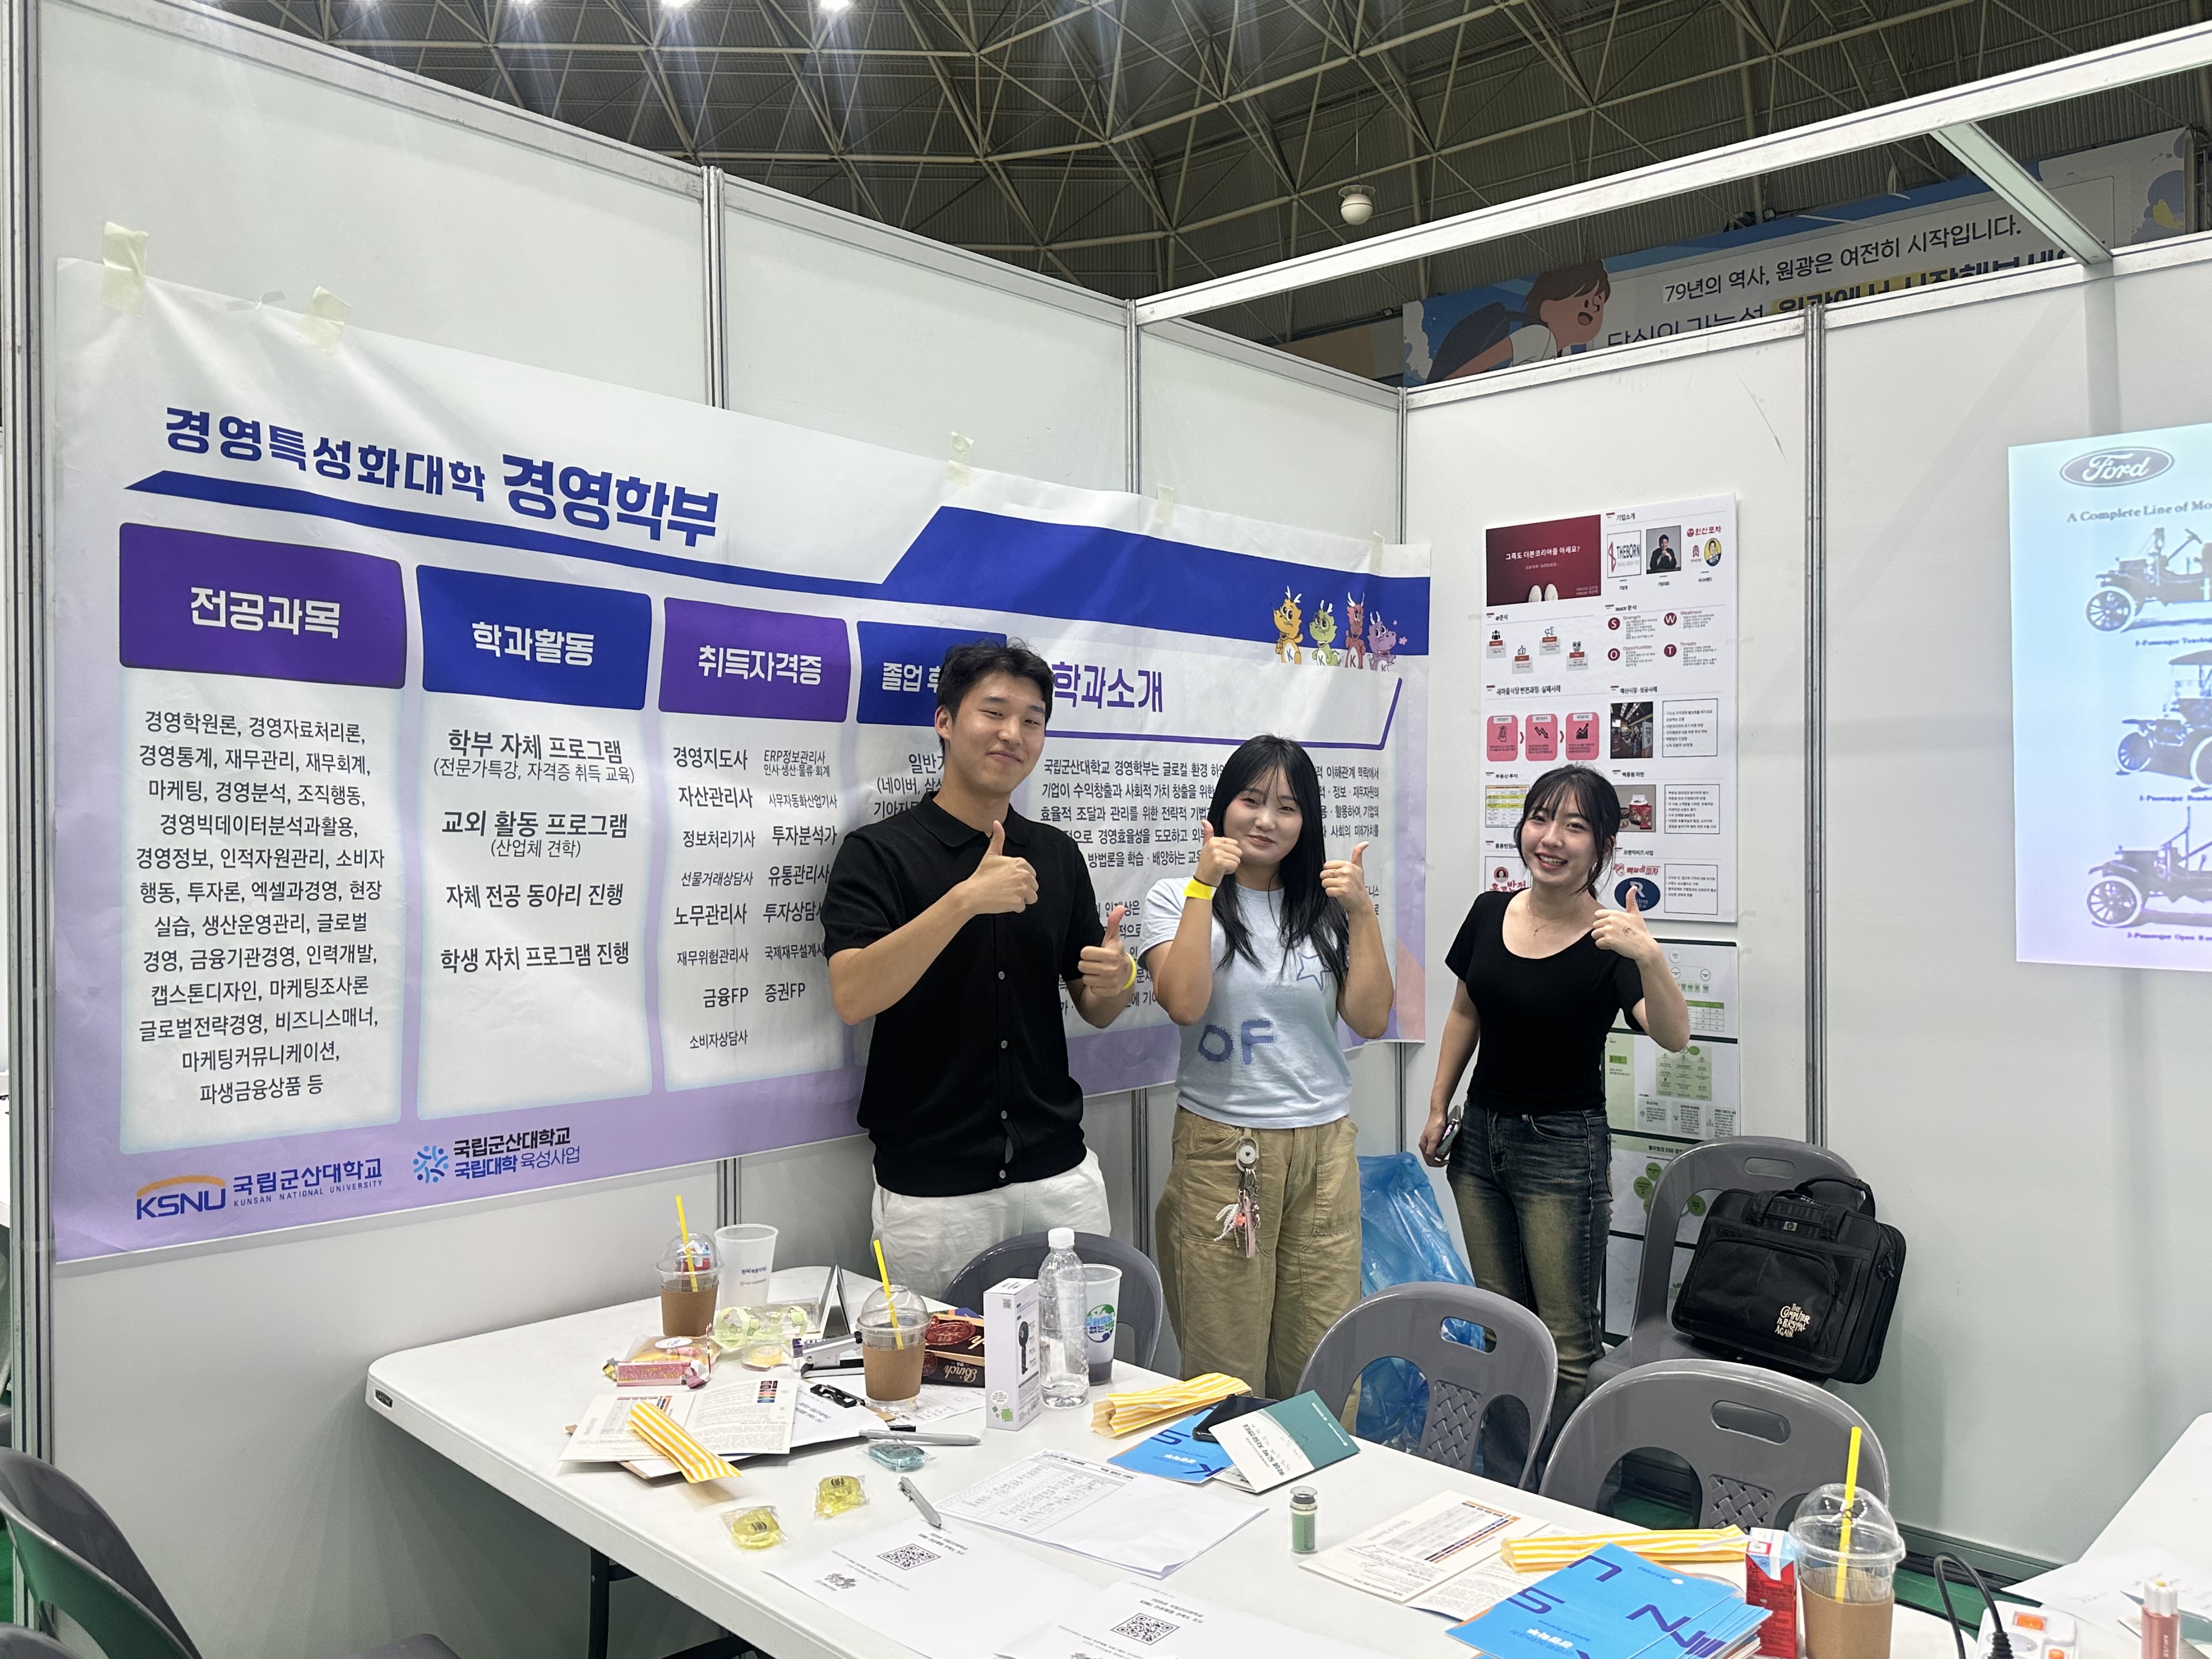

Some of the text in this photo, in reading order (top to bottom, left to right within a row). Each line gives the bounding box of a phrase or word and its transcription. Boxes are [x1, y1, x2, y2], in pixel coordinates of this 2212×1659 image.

[1664, 214, 2022, 302] 79년의 역사, 원광은 여전히 시작입니다.
[166, 407, 718, 547] 경영특성화대학 경영학부
[2082, 453, 2151, 481] Ford
[1617, 513, 1635, 521] 기업소개
[2067, 503, 2187, 522] A Complete Line of
[1617, 544, 1640, 560] THEBORN
[190, 587, 340, 639] 전공과목
[1612, 619, 1617, 628] S
[1666, 615, 1675, 624] W
[472, 622, 594, 667] 학과활동
[698, 645, 822, 686] 취득자격증
[882, 662, 920, 693] 졸업
[1052, 662, 1162, 713] 학과소개
[145, 711, 365, 744] 경영학원론, 경영자료처리론,
[449, 729, 623, 765] 학부 자체 프로그램
[673, 747, 748, 770] 경영지도사
[764, 749, 825, 765] ERP정보관리사
[140, 744, 370, 776] 경영통계, 재무관리, 재무회계,
[434, 758, 634, 783] (전문가특강, 자격증 취득 교육)
[1045, 759, 1207, 777] 국립군산대학교 경영학부는 글로컬 환경
[1327, 766, 1355, 779] 이해관계
[149, 780, 365, 806] 마케팅, 경영분석, 조직행동,
[679, 786, 753, 808] 자산관리사
[877, 777, 920, 794] (네이버,
[1042, 783, 1070, 799] 기업이
[1073, 783, 1122, 799] 수익창출과
[1126, 783, 1151, 798] 사회적
[1154, 785, 1170, 799] 가치
[1172, 785, 1196, 799] 창출을
[1333, 786, 1346, 798] 정보
[769, 794, 837, 809] 사무자동화산업기사
[442, 810, 628, 838] 교외 활동 프로그램
[1041, 806, 1186, 821] 효율적 조달과 관리를 위한 전략적
[160, 814, 357, 838] 경영빅데이터분석과활용,
[772, 825, 837, 846] 투자분석가
[1098, 829, 1187, 844] 경영효율성을 도모하고
[1331, 825, 1350, 838] 사회의
[491, 839, 581, 857] (산업체 견학)
[683, 830, 755, 848] 정보처리기사
[136, 848, 385, 870] 경영정보, 인적자원관리, 소비자
[1088, 850, 1185, 868] 방법론을 학습 배양하는
[681, 871, 753, 887] 선물거래상담사
[769, 864, 830, 886] 유통관리사
[140, 881, 381, 904] 행동, 투자론, 엑셀과경영, 현장
[446, 883, 624, 909] 자체 전공 동아리 진행
[155, 912, 366, 938] 실습, 생산운영관리, 글로벌
[674, 903, 747, 926] 노무관리사
[143, 944, 376, 973] 경영, 금융기관경영, 인력개발,
[441, 941, 629, 973] 학생 자치 프로그램 진행
[677, 947, 748, 966] 재무위험관리사
[151, 975, 369, 1006] 캡스톤디자인, 마케팅조사론
[703, 988, 748, 1008] 금융FP
[765, 982, 805, 1003] 증권FP
[140, 1006, 377, 1042] 글로벌전략경영, 비즈니스매너,
[690, 1029, 748, 1049] 소비자상담사
[1199, 1018, 1277, 1065] OF
[183, 1041, 339, 1072] 마케팅커뮤니케이션,
[200, 1074, 323, 1104] 파생금융상품 등
[453, 1127, 571, 1158] 국립군산대학교
[454, 1146, 580, 1180] 국립대학 육성사업
[233, 1158, 382, 1195] 국립군산대학교
[136, 1188, 226, 1221] KSNU
[234, 1180, 383, 1207] KUNSAN NATIONAL UNIVERSITY
[1780, 1306, 1810, 1324] COMPUTER
[1774, 1325, 1793, 1338] AGAIN
[943, 1365, 977, 1383] Binch
[1261, 1449, 1275, 1462] 도박
